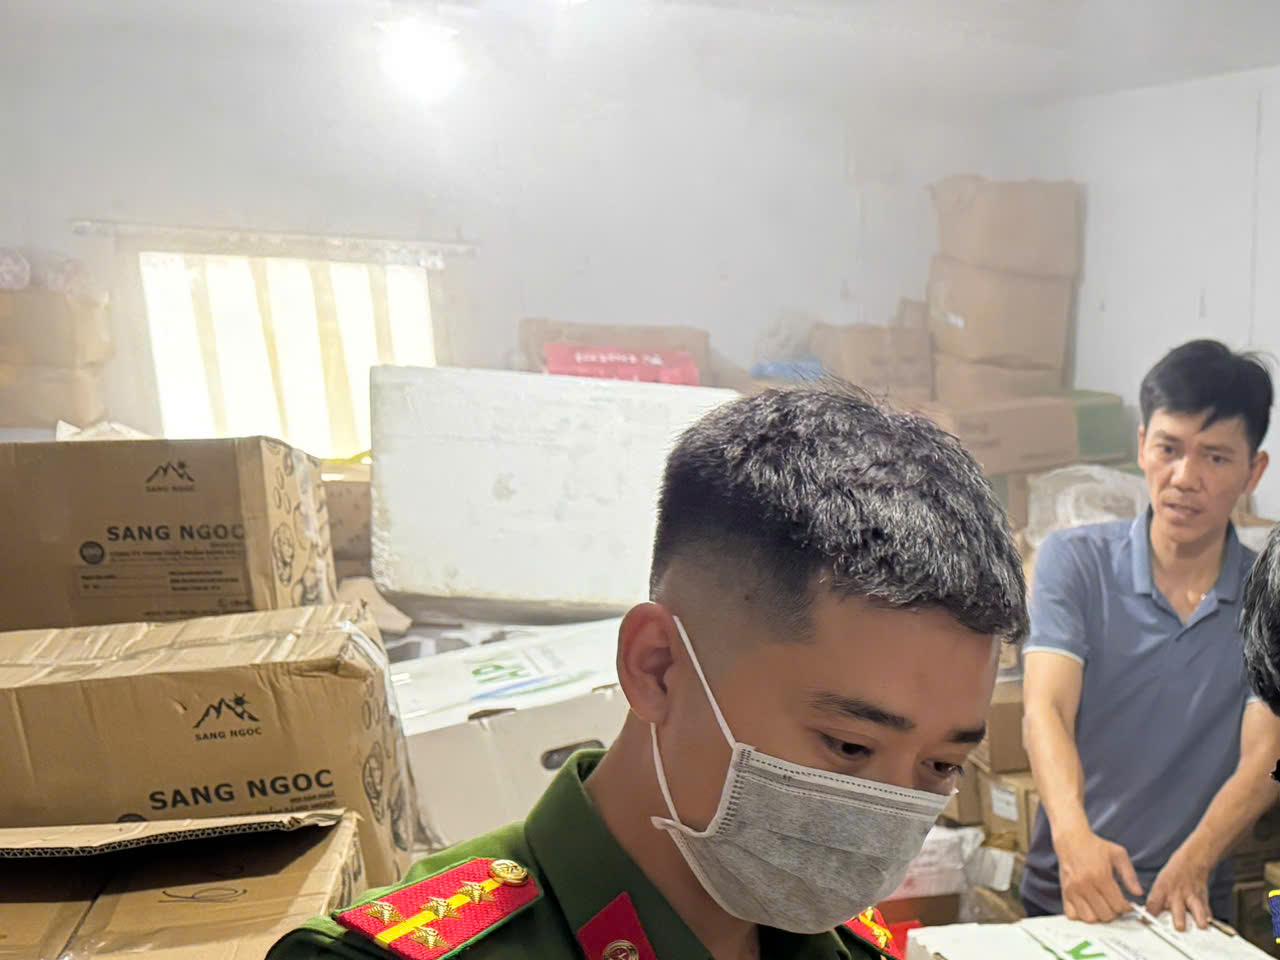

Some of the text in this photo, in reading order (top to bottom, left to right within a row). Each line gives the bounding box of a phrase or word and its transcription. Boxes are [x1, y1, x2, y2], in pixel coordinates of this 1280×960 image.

[106, 524, 245, 542] SANG NGOC
[195, 727, 263, 742] SANG NGOC
[148, 783, 235, 811] SANG
[247, 769, 335, 798] NGOC
